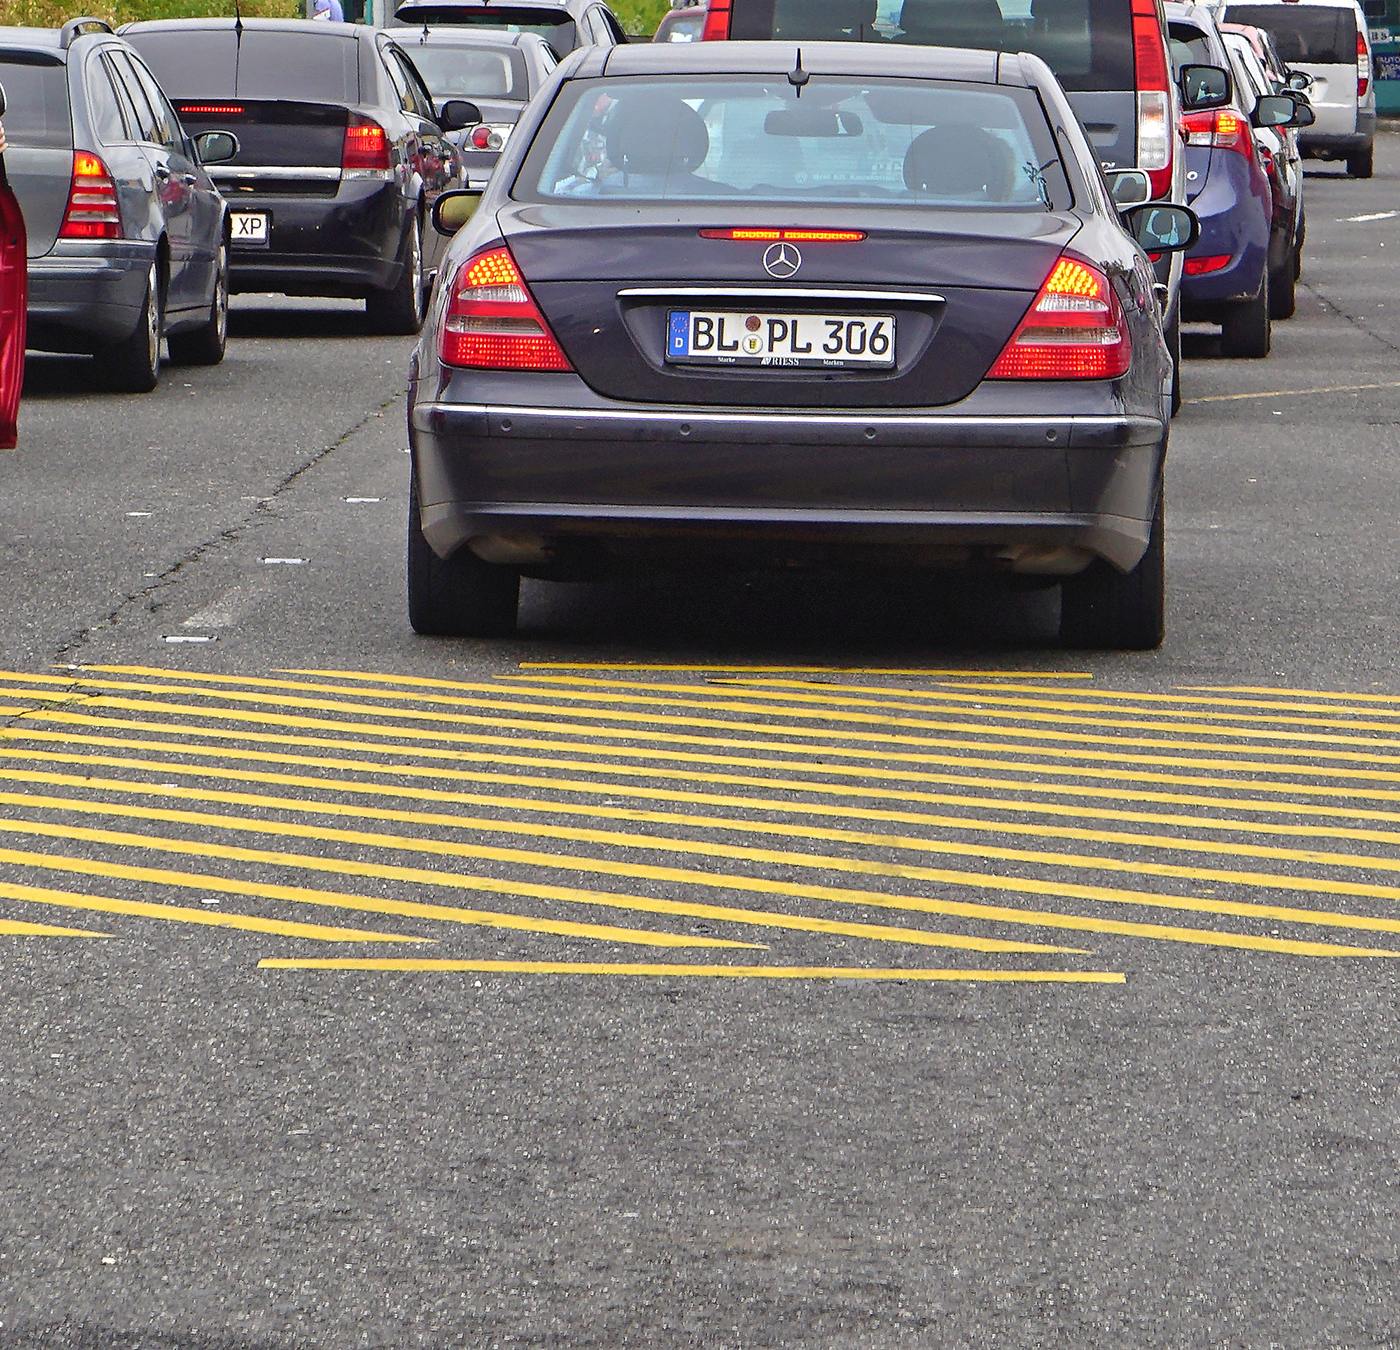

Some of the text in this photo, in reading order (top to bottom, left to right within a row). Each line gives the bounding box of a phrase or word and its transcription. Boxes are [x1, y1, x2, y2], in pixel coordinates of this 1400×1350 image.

[239, 217, 262, 235] XP
[674, 317, 890, 355] D BL PL 306
